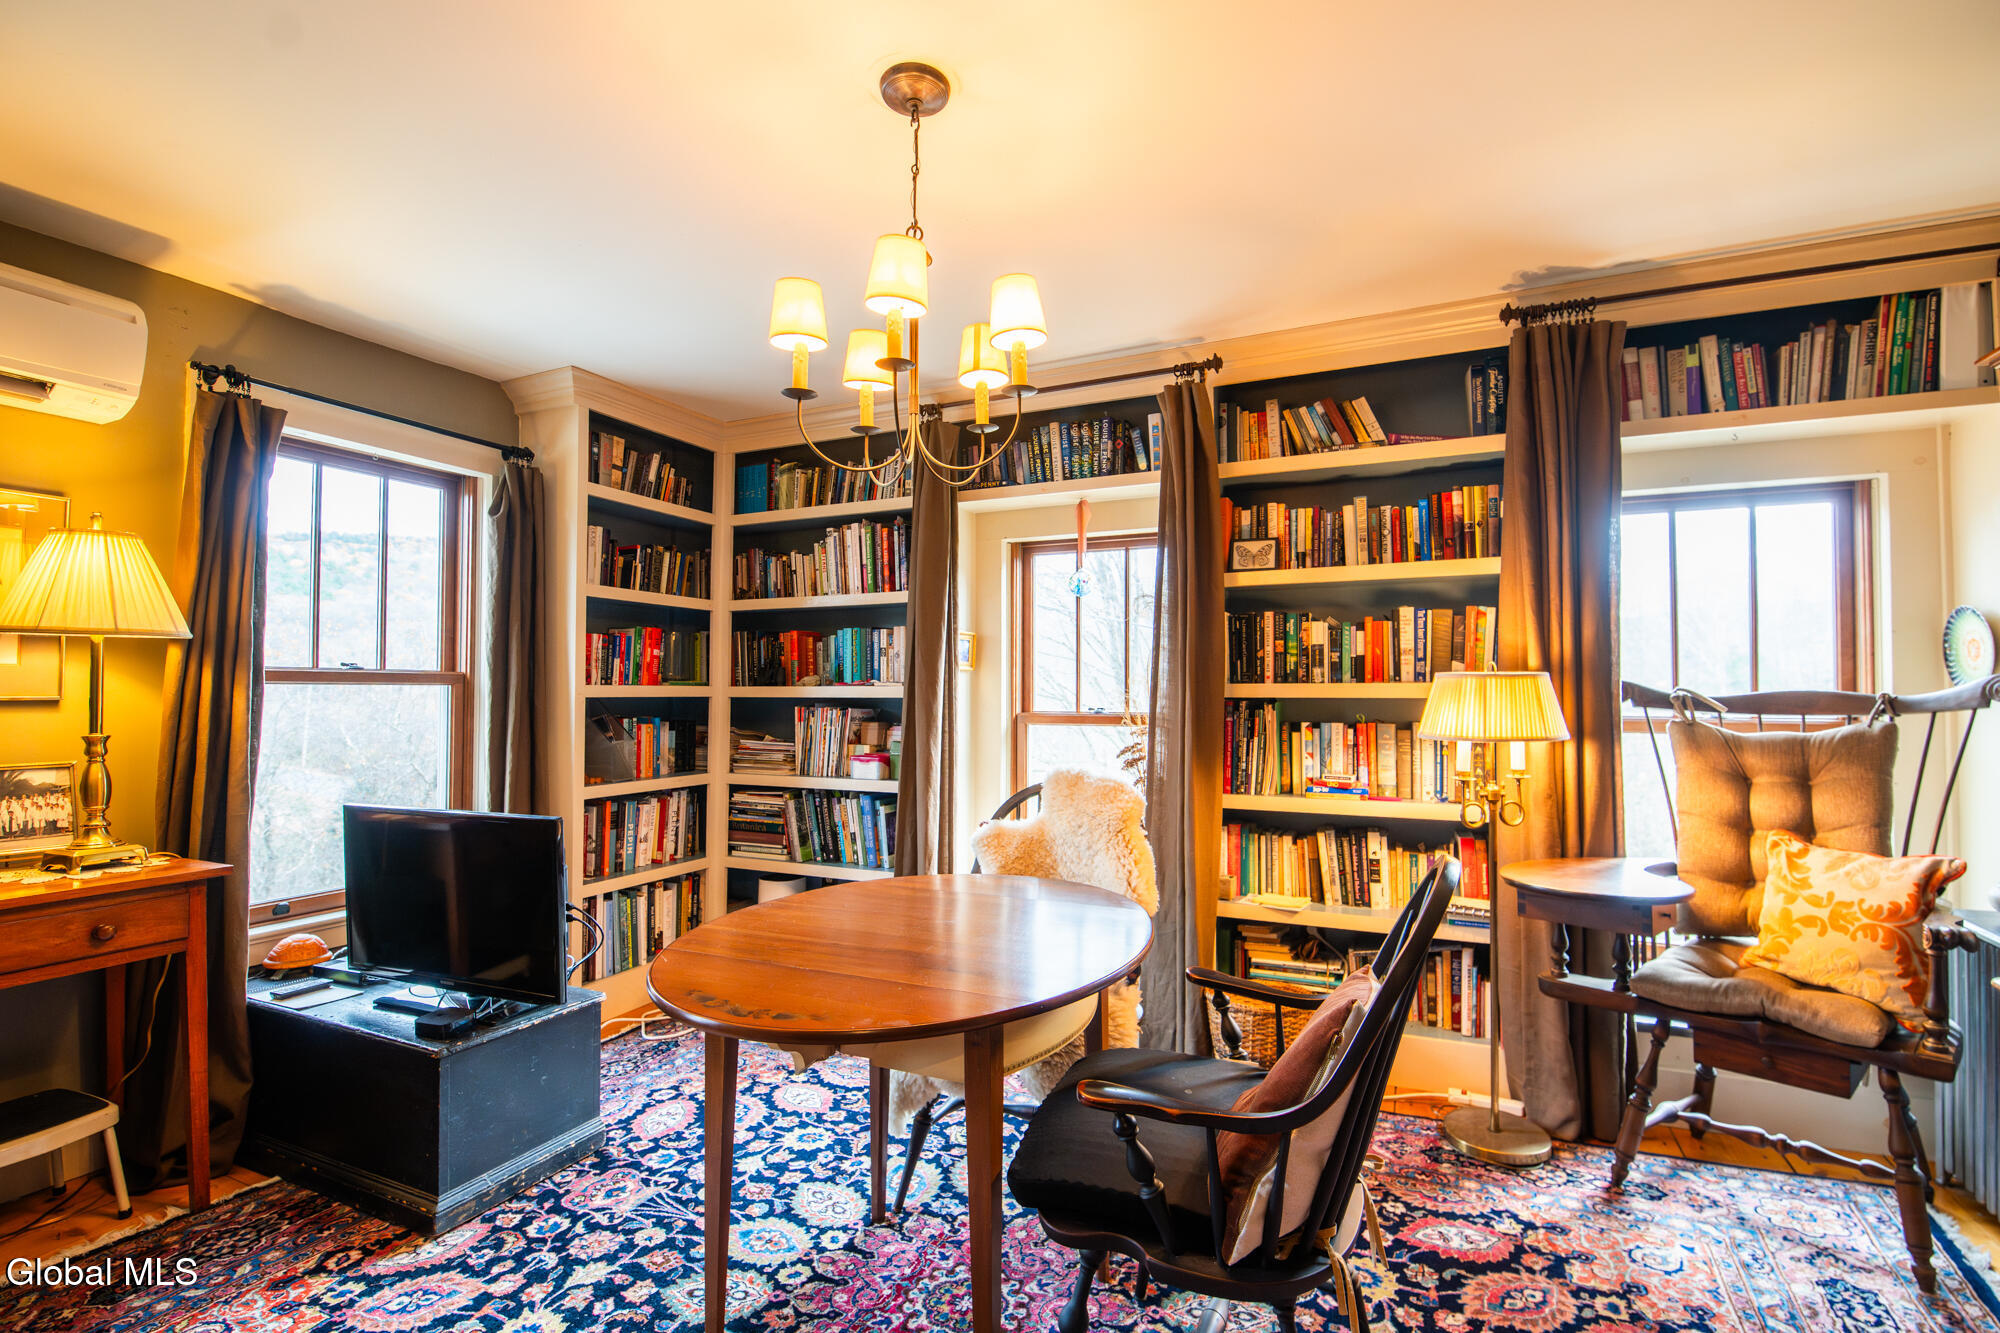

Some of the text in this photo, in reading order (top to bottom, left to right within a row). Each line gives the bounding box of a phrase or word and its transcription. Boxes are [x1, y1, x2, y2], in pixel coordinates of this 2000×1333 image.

[1864, 344, 1876, 366] RISK
[1032, 432, 1043, 480] LOUISE PENNY
[1072, 424, 1080, 478] LOUISE PENNY
[1044, 458, 1052, 479] PENNY
[1062, 456, 1070, 478] PENNY
[1082, 454, 1090, 476] PENNY
[1092, 453, 1100, 475] PENNY
[670, 810, 678, 846] PLENTY
[731, 822, 766, 832] Botanica
[626, 823, 634, 854] PEPIN
